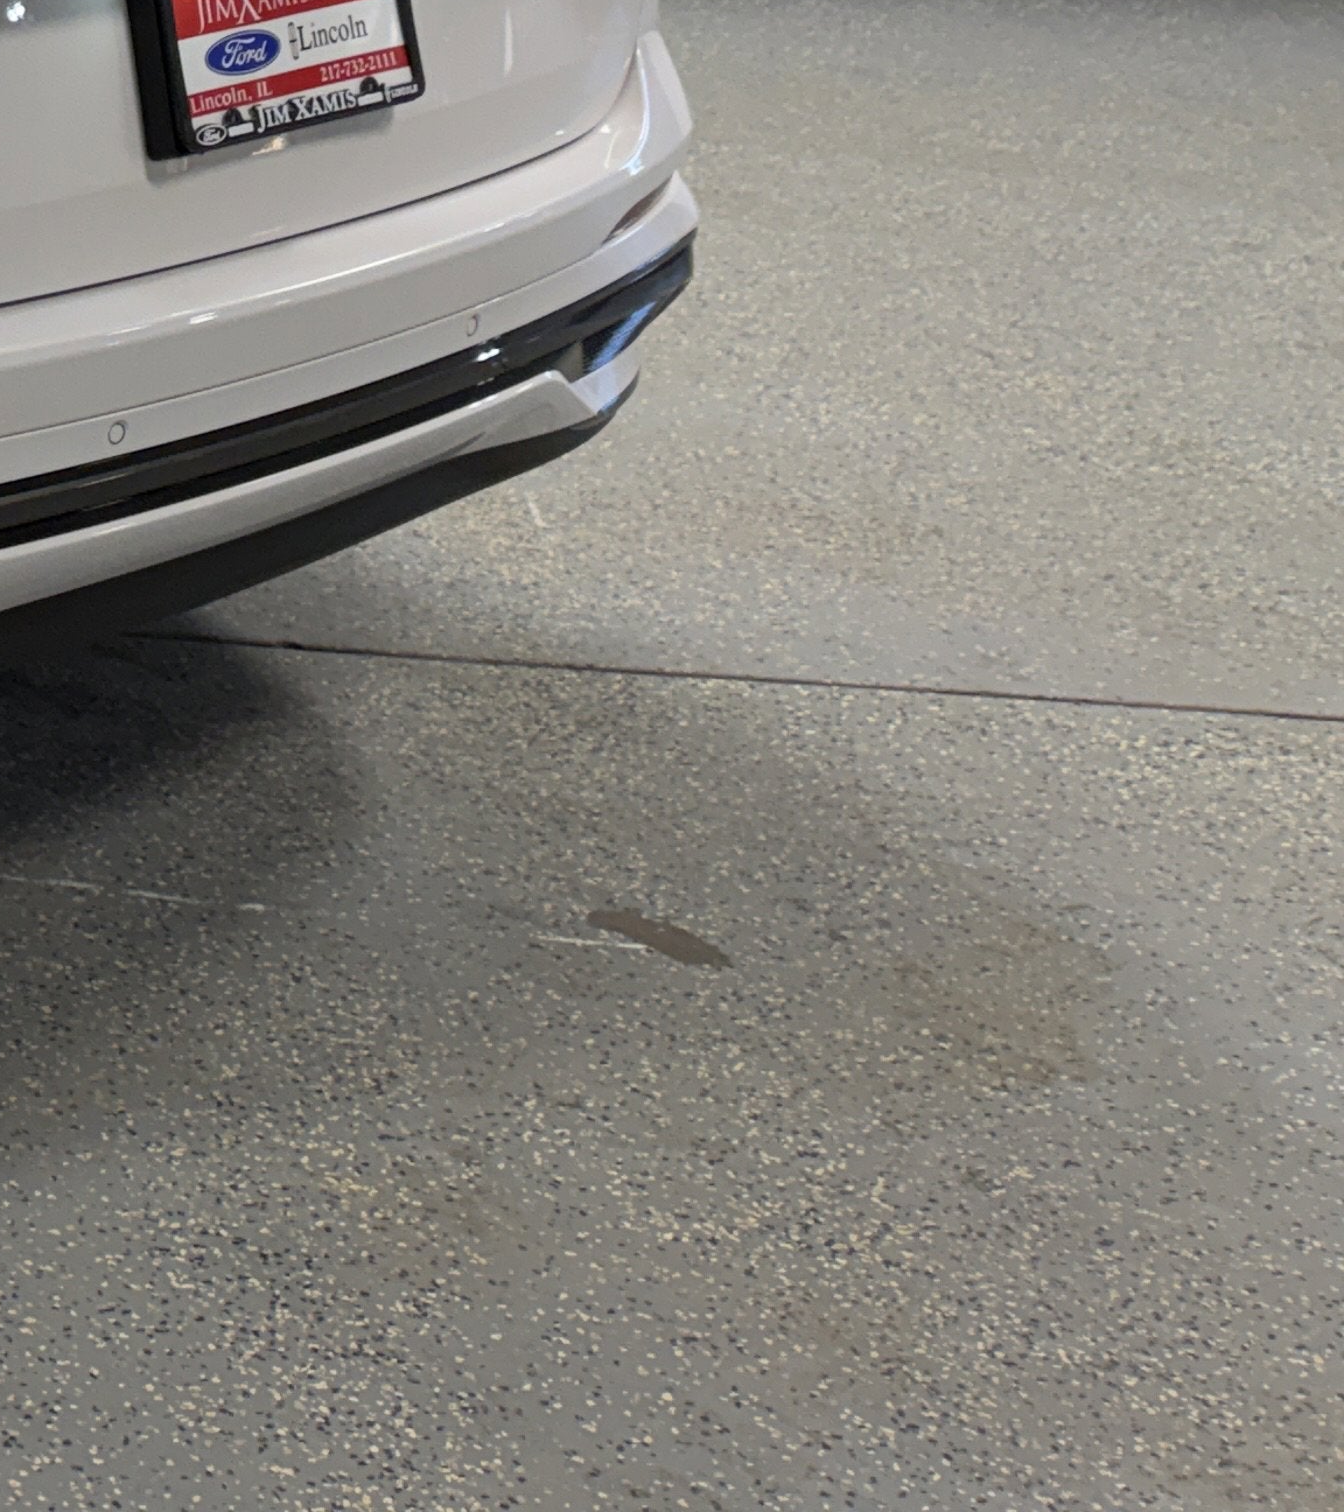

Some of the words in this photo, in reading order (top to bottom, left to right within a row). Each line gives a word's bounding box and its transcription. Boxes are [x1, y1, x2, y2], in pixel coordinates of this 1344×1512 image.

[298, 15, 369, 52] Lincoln
[221, 37, 267, 69] Ford
[319, 51, 398, 82] 217-732-2111
[257, 81, 273, 97] IL
[257, 104, 292, 133] JIM
[295, 90, 357, 120] XAMIS
